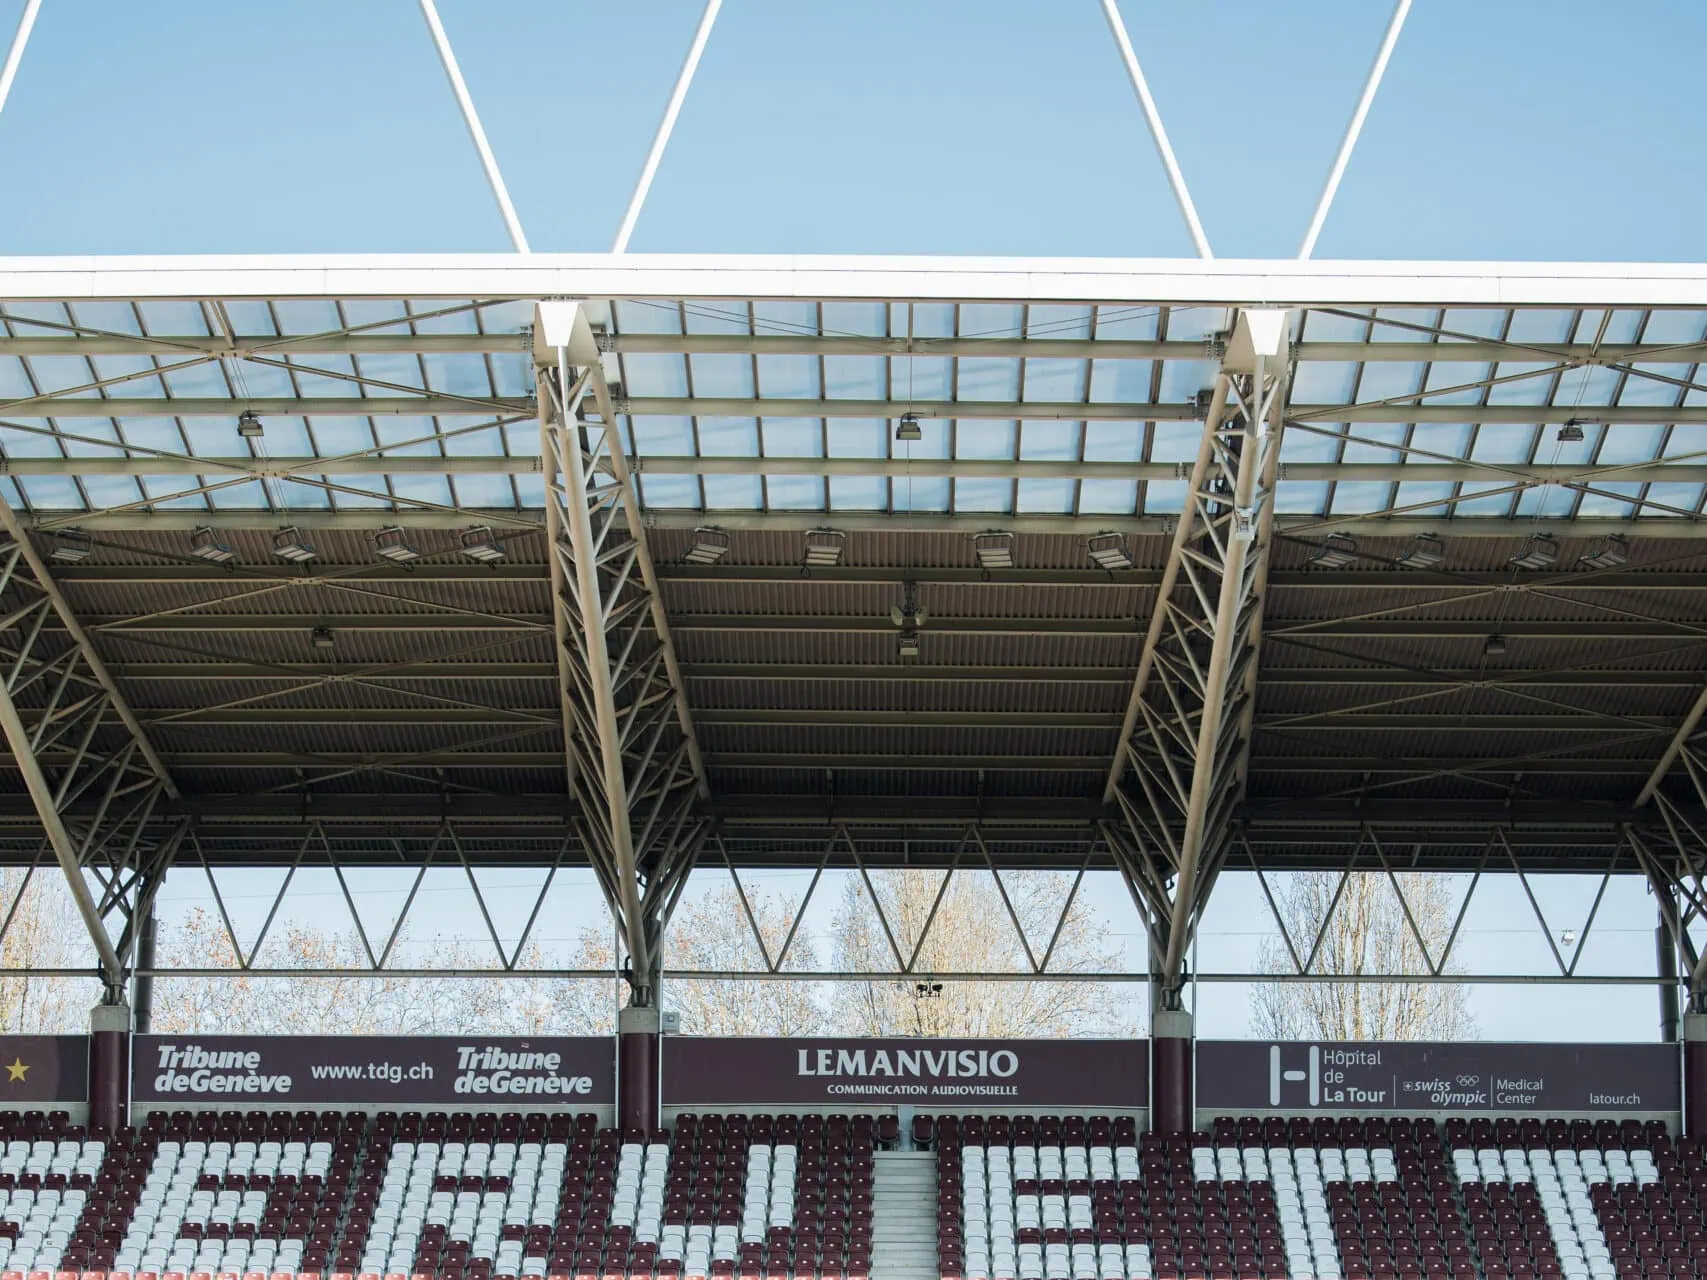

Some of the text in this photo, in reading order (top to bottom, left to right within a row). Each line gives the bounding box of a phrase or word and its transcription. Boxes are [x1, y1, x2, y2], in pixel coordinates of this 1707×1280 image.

[157, 1045, 261, 1070] Tribune
[456, 1046, 562, 1072] Tribune
[797, 1048, 1019, 1078] LEMANVISIO
[1324, 1049, 1382, 1068] Hôpital
[311, 1060, 434, 1085] www.tdg.ch
[1324, 1069, 1344, 1084] de
[826, 1083, 1019, 1096] COMMUNICATION AUDIOVISUELLE
[1414, 1078, 1452, 1092] swiss
[1496, 1078, 1543, 1091] Medical
[1324, 1088, 1386, 1104] La Tour
[1430, 1089, 1488, 1107] olympic
[1496, 1092, 1537, 1105] Center
[1589, 1091, 1641, 1106] latour.ch
